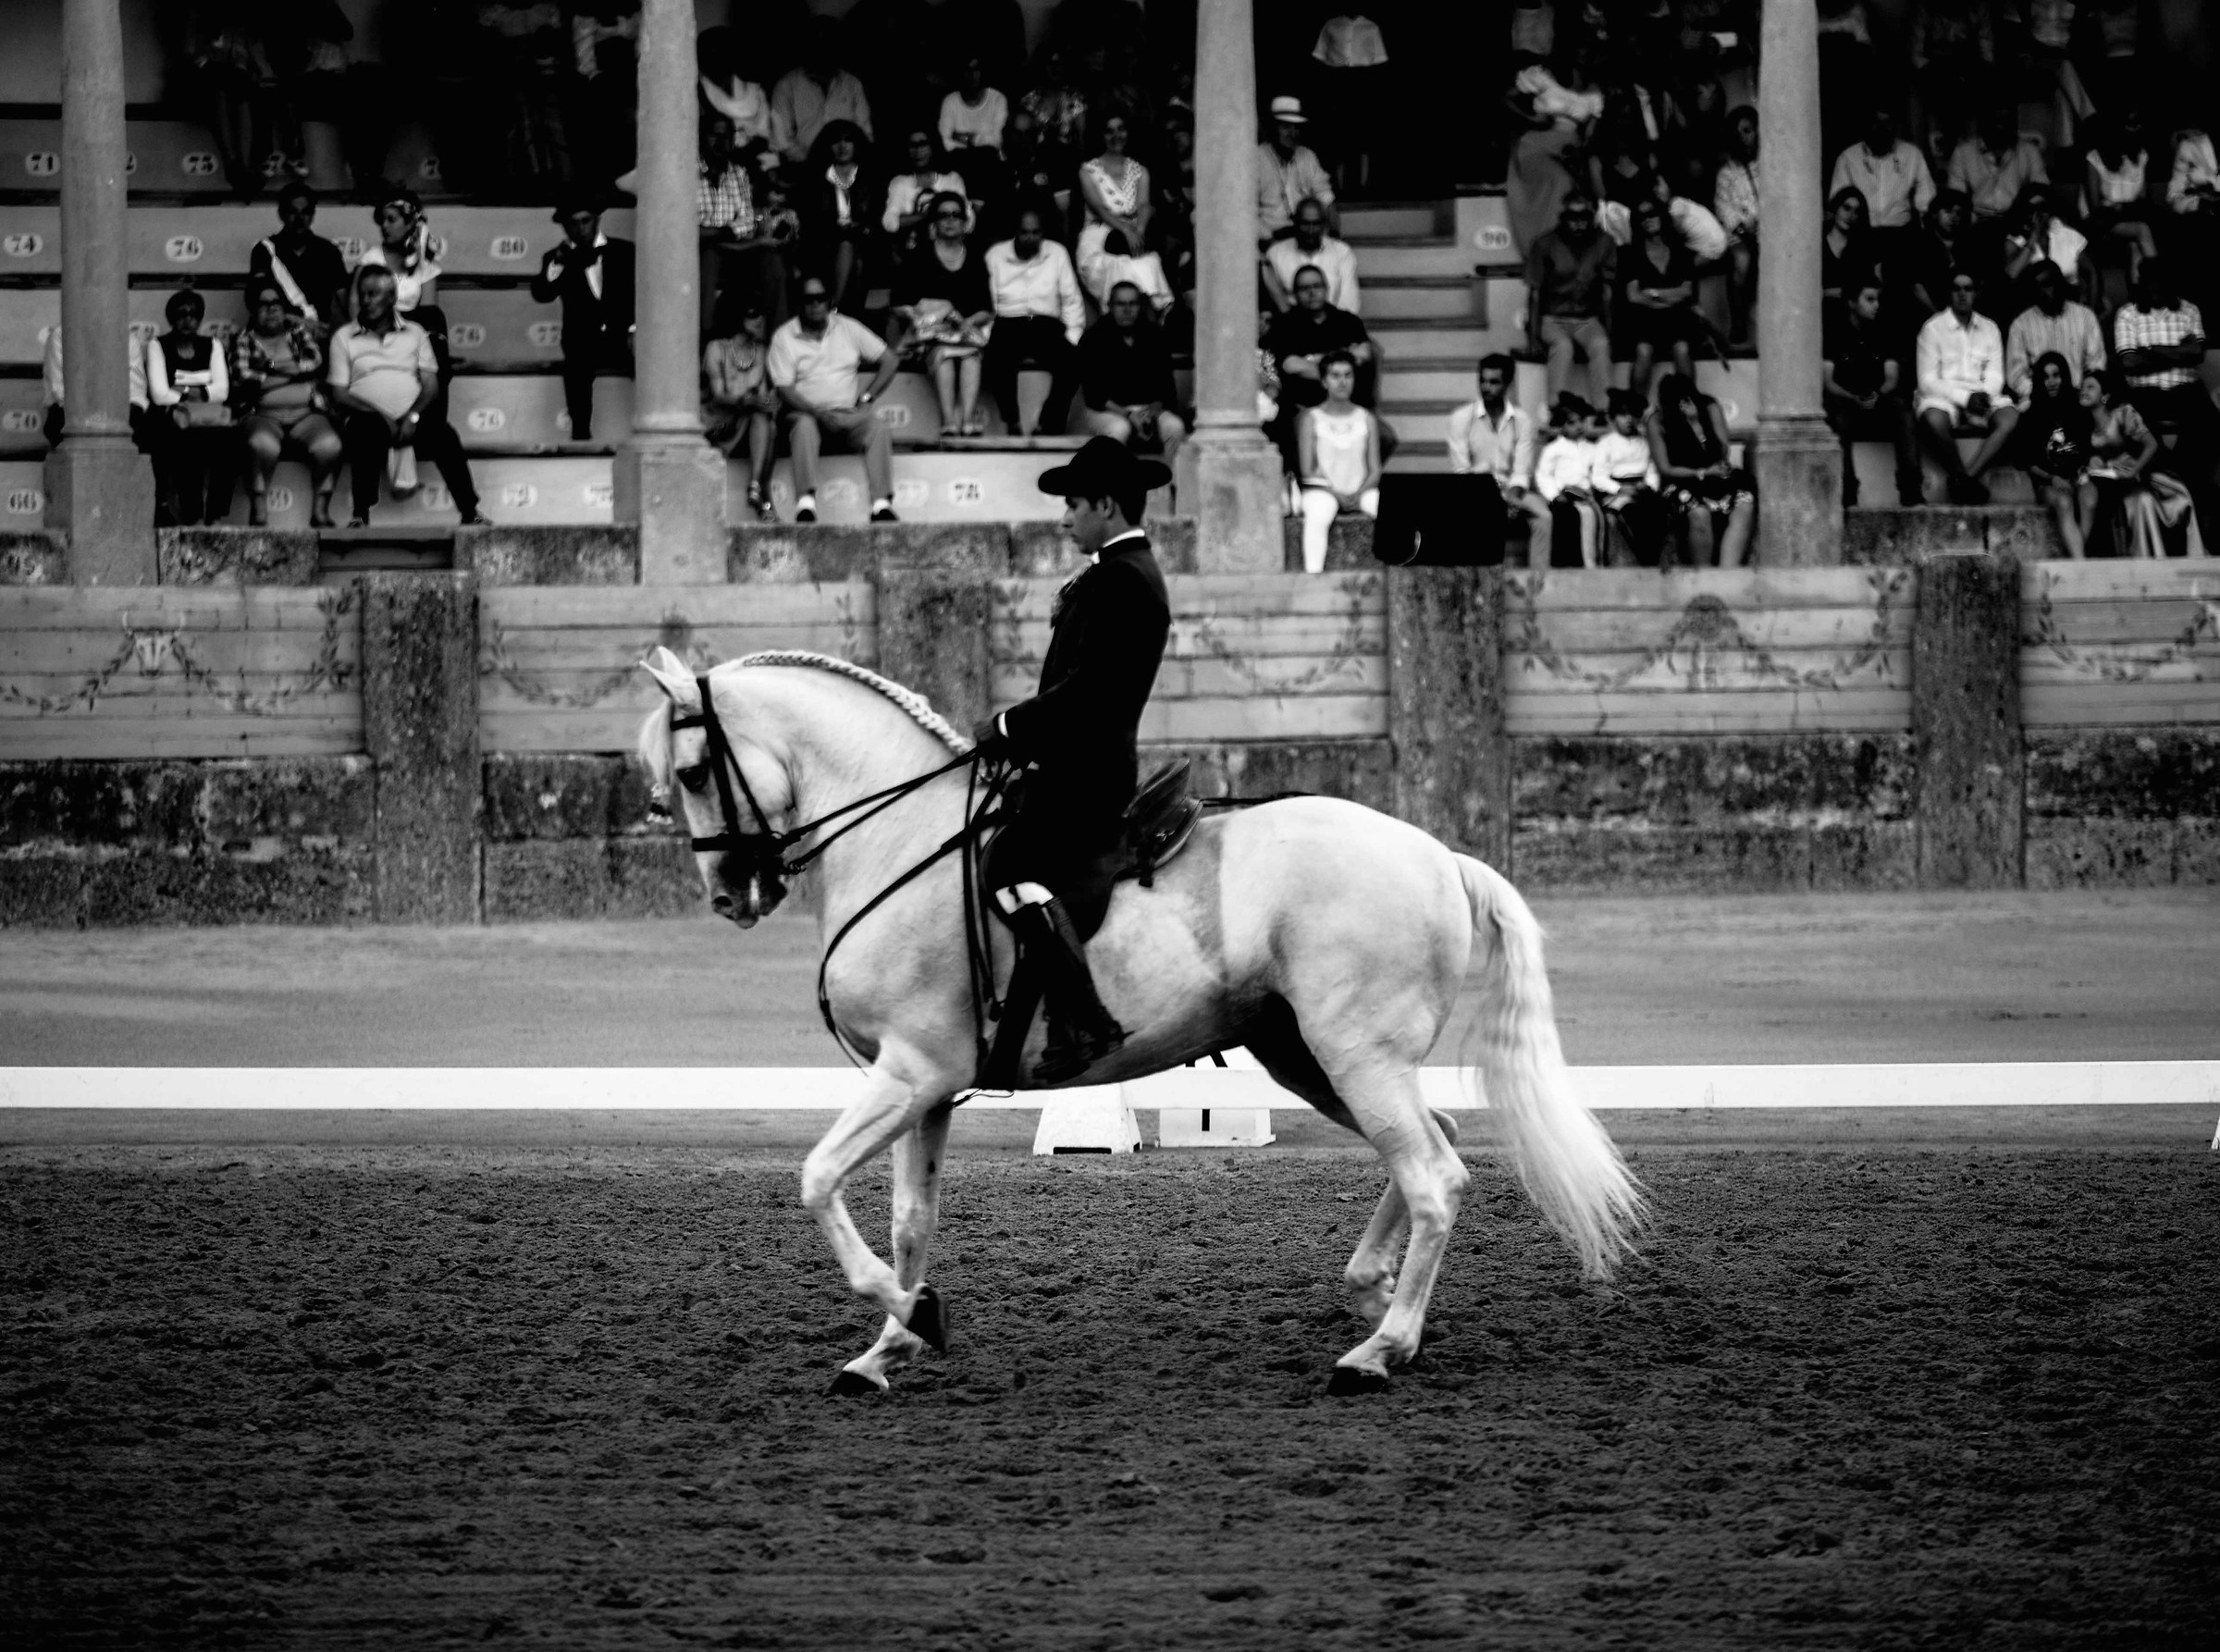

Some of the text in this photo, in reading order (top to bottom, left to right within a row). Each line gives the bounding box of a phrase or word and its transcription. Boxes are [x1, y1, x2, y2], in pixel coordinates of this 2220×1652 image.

[31, 154, 54, 172] 71
[11, 235, 36, 253] 74
[174, 238, 199, 256] 76
[500, 239, 525, 256] 80
[455, 327, 480, 344] 76
[12, 412, 37, 429] 70
[9, 492, 37, 510] 66
